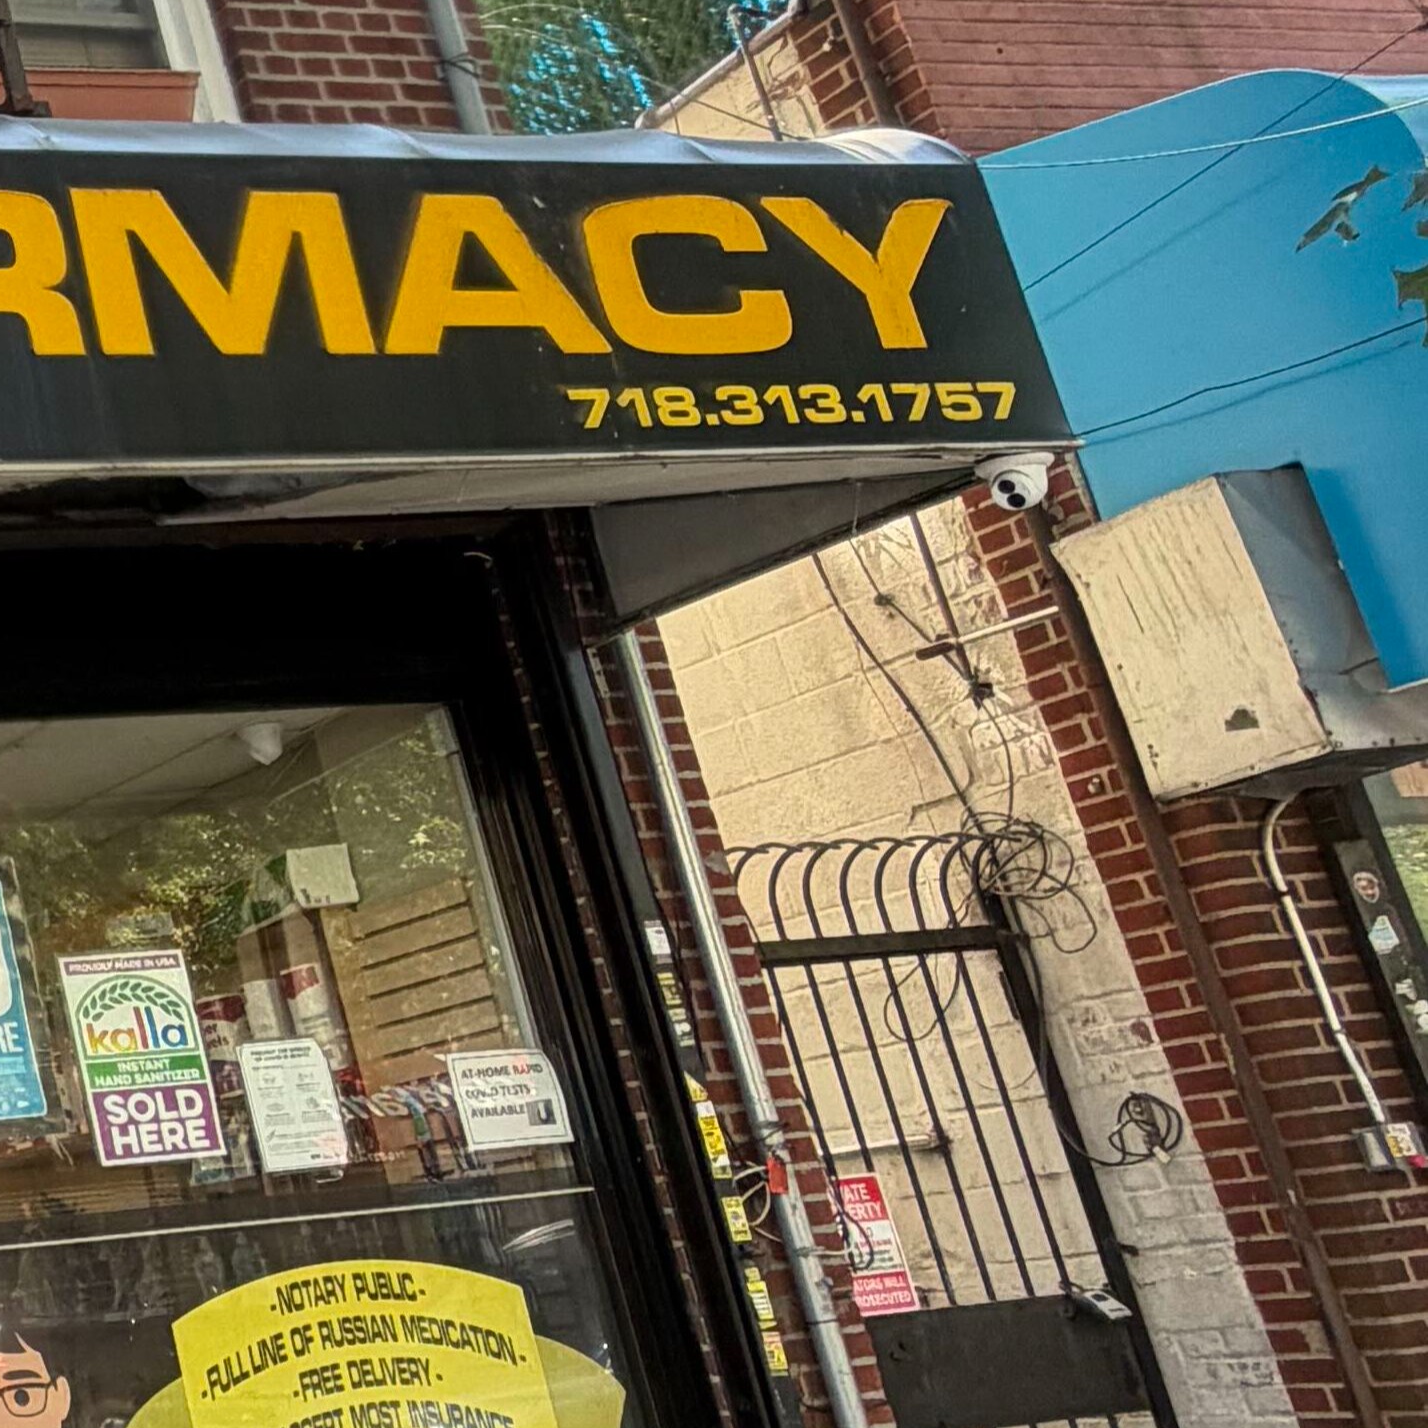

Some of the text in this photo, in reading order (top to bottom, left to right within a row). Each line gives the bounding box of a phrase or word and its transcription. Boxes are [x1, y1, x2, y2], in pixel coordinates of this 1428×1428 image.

[566, 381, 1017, 430] 718.313.1757
[155, 956, 177, 968] USA
[86, 1006, 189, 1054] kalla
[95, 1069, 201, 1087] HAND SANITIZER
[117, 1059, 170, 1072] INSTANT
[103, 1089, 204, 1124] SOLD
[471, 1104, 526, 1119] AVAILABLE
[110, 1118, 210, 1156] HERE
[856, 1291, 911, 1308] ROSECUTED
[249, 1333, 288, 1373] LINE
[293, 1324, 314, 1358] OF
[317, 1314, 399, 1350] RUSSIAN
